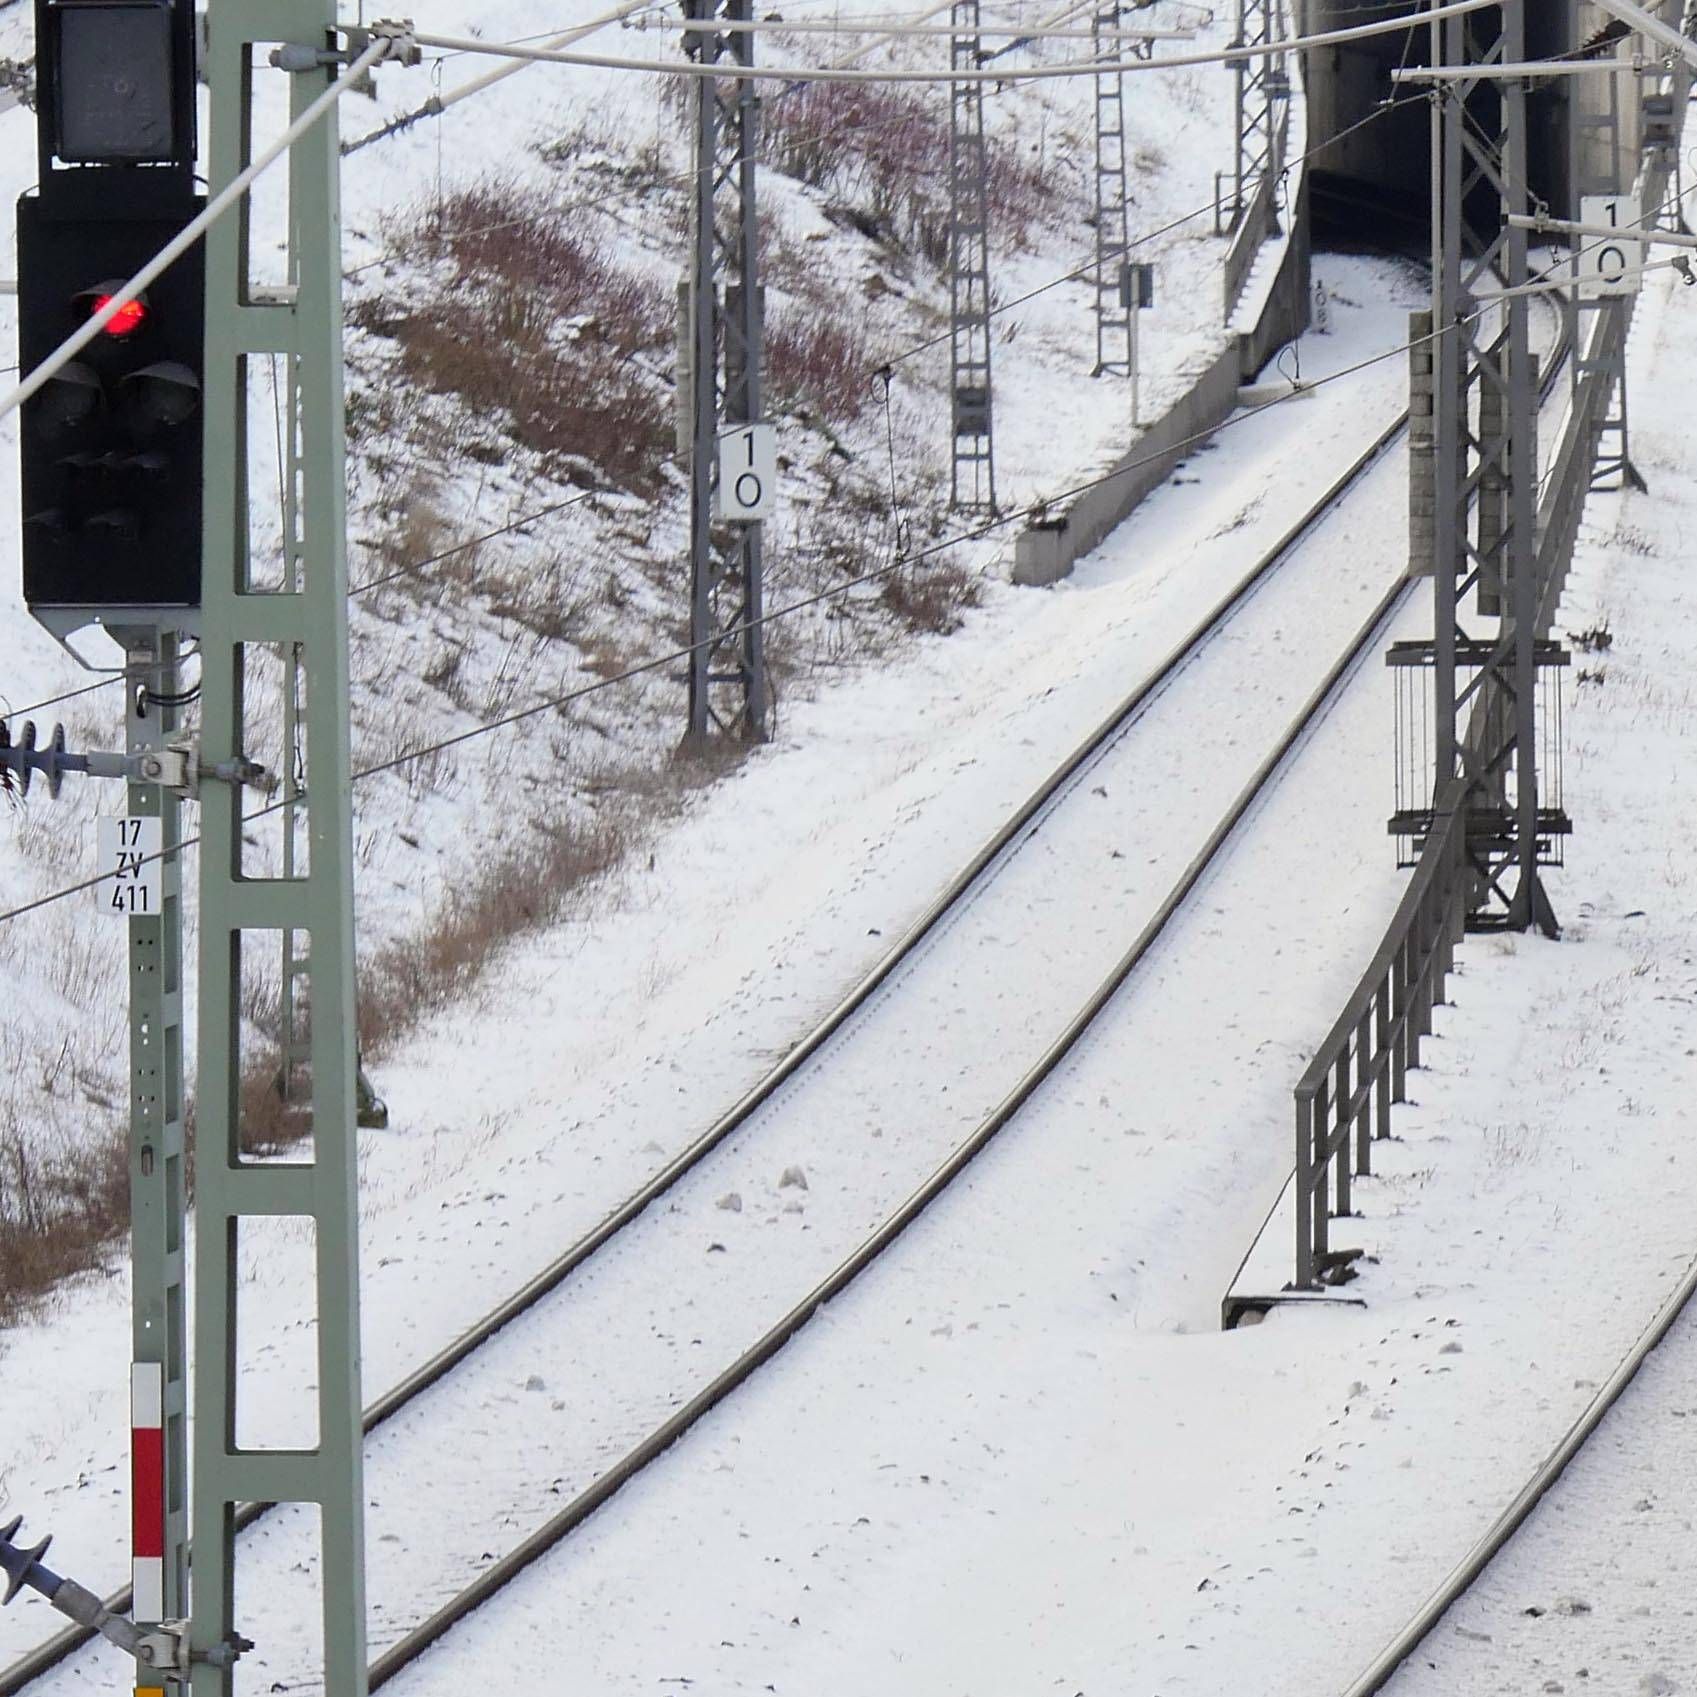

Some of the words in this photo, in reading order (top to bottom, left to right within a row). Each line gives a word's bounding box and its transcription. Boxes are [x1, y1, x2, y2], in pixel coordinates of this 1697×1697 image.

[1605, 202, 1616, 228] 1
[1598, 246, 1625, 283] 0
[742, 431, 753, 467] 1
[735, 472, 762, 508] 0
[118, 819, 142, 846] 17
[116, 852, 143, 879] ZV
[112, 884, 148, 912] 411
